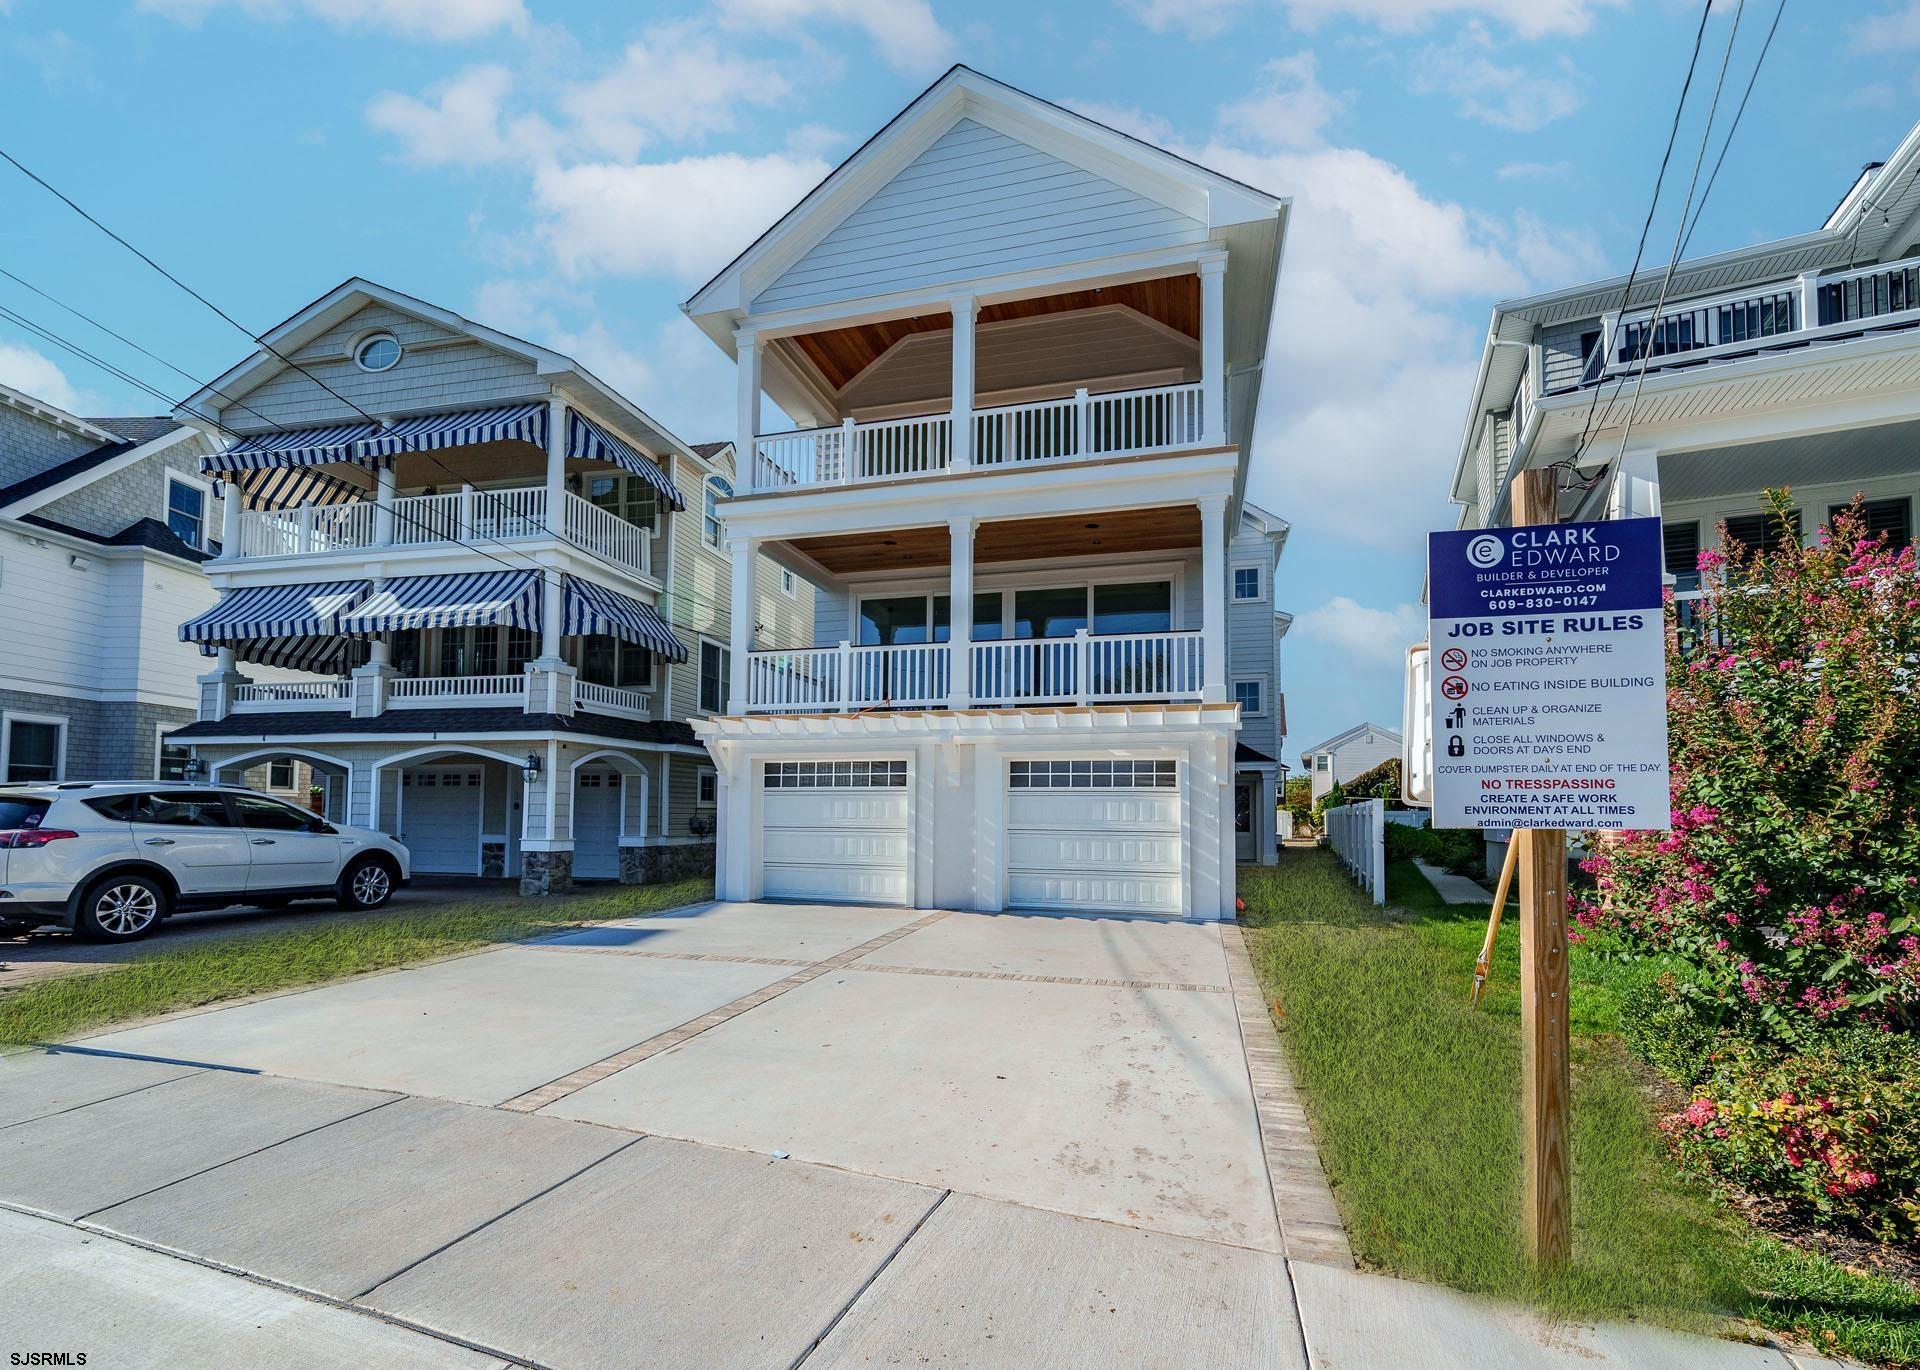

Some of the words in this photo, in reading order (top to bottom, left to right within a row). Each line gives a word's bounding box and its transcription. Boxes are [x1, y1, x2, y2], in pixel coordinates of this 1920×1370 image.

[1511, 527, 1597, 548] CLARK
[1512, 545, 1620, 567] EDWARD
[1476, 571, 1523, 583] BUILDER
[1528, 571, 1537, 579] &
[1541, 566, 1609, 578] DEVELOPER
[1481, 584, 1606, 598] CLARKEDWARD.COM
[1489, 596, 1597, 610] 609-830-0147
[1448, 622, 1494, 638] JOB
[1502, 620, 1555, 635] SITE
[1563, 615, 1643, 632] RULES
[1471, 649, 1487, 658] NO
[1490, 647, 1543, 656] SMOKING
[1546, 644, 1612, 655] ANYWHERE
[1471, 659, 1487, 668] ON
[1490, 658, 1512, 667] JOB
[1515, 657, 1578, 667] PROPERTY
[1471, 682, 1490, 692] NO
[1493, 681, 1539, 691] EATING
[1544, 679, 1586, 690] INSIDE
[1591, 677, 1654, 688] BUILDING
[1472, 706, 1509, 715] CLEAN
[1512, 705, 1528, 714] UP
[1532, 705, 1539, 713] &
[1542, 704, 1601, 713] ORGANIZE
[1472, 716, 1535, 725] MATERIALS
[1473, 735, 1510, 744] CLOSE
[1513, 735, 1533, 743] ALL
[1535, 734, 1594, 743] WINDOWS
[1597, 734, 1605, 742] &
[1473, 746, 1514, 755] DOORS
[1516, 746, 1531, 754] AT
[1534, 745, 1563, 754] DAYS
[1566, 745, 1591, 754] END
[1438, 765, 1472, 774] COVER
[1475, 765, 1528, 773] DUMPSTER
[1532, 765, 1559, 773] DAILY
[1560, 765, 1573, 773] AT
[1575, 764, 1597, 772] END
[1600, 764, 1614, 772] OF
[1616, 763, 1637, 772] THE
[1640, 763, 1663, 772] DAY.
[1481, 780, 1501, 789] NO
[1505, 778, 1615, 789] TRESSPASSING
[1480, 795, 1527, 803] CREATE
[1543, 794, 1574, 803] SAFE
[1578, 794, 1617, 803] WORK
[1464, 806, 1551, 815] ENVIRONMENT
[1553, 806, 1570, 814] AT
[1571, 806, 1596, 814] ALL
[1597, 806, 1635, 814] TIMES
[1477, 819, 1623, 828] admin@clarkedward.com
